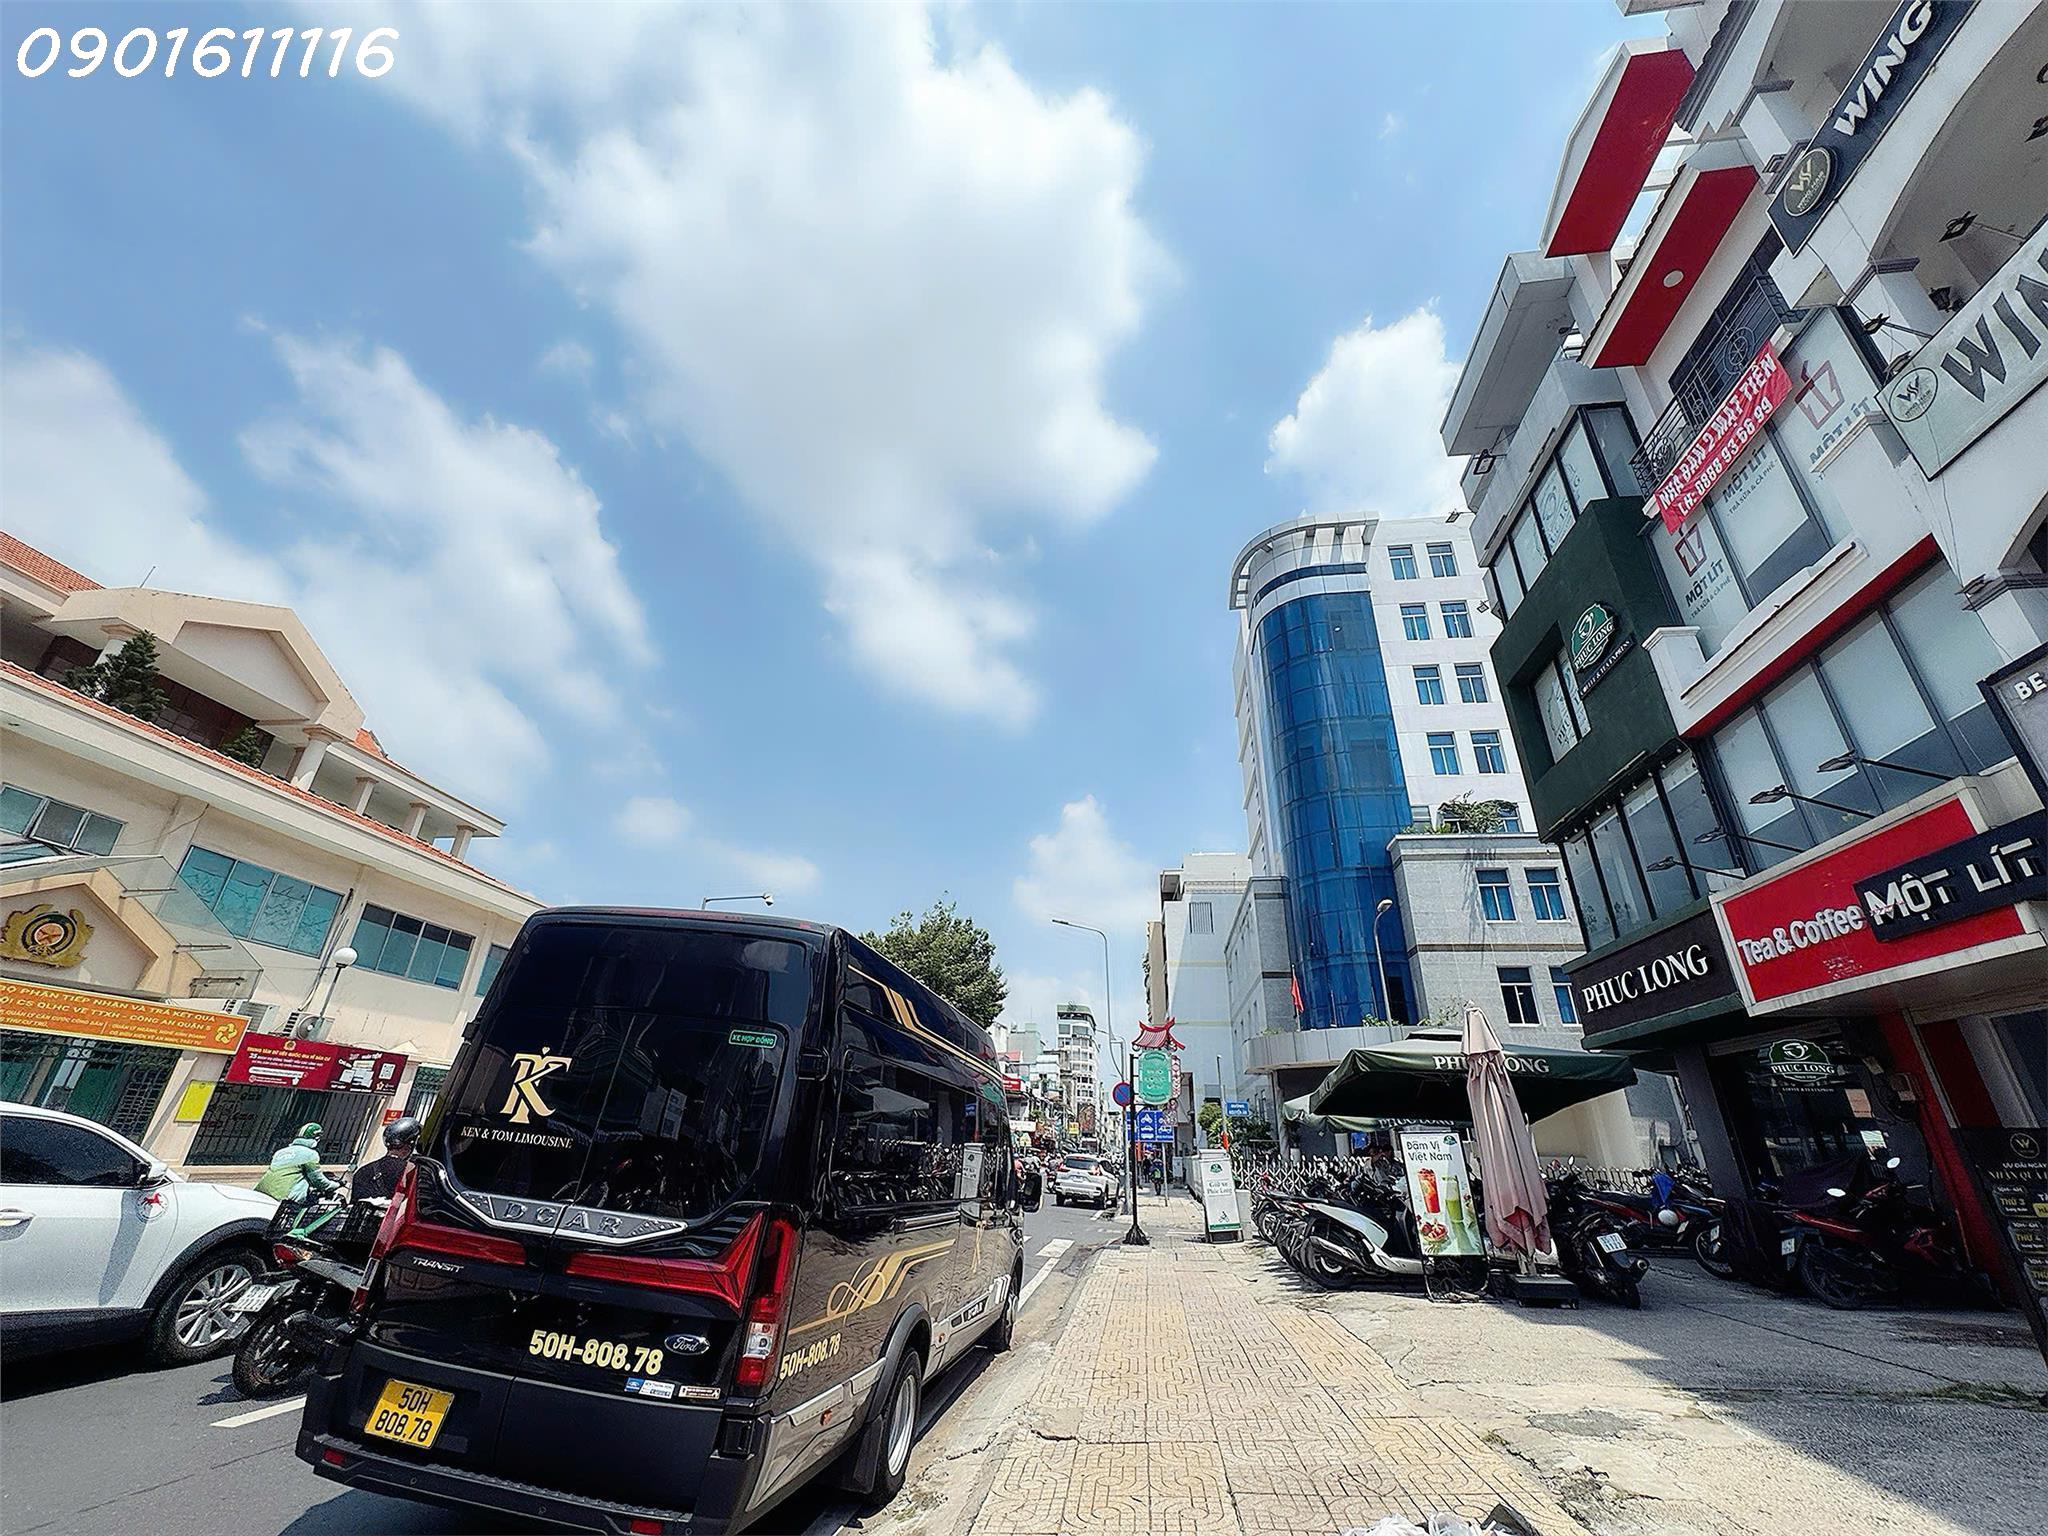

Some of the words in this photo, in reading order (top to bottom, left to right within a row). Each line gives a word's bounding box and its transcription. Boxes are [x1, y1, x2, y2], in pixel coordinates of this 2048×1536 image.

[1833, 0, 1933, 137] WING
[1702, 431, 1716, 452] 2
[1695, 457, 1723, 496] 0888
[1721, 440, 1740, 464] 93
[1685, 576, 1708, 607] MỘT
[1574, 642, 1593, 670] PHUC
[1592, 621, 1614, 647] LONG
[1864, 869, 1949, 927] MỘT
[1966, 838, 2034, 893] LÍT
[1582, 970, 1639, 1013] PHUC
[1637, 944, 1709, 994] LONG
[1771, 1064, 1801, 1074] PHUC
[1803, 1064, 1835, 1074] LONG
[461, 1126, 482, 1138] KEN
[481, 1128, 490, 1140] &
[491, 1130, 514, 1142] TOM
[514, 1132, 574, 1149] LIMOUSINE
[1408, 1151, 1428, 1163] Việt
[1429, 1152, 1453, 1161] Nam
[504, 1202, 623, 1235] DCAR
[413, 1256, 464, 1273] TRANSIT
[529, 1329, 664, 1375] 50H-808.78
[780, 1332, 841, 1380] 50H-808.78
[398, 1387, 433, 1414] 50H
[375, 1409, 432, 1442] 808.78
